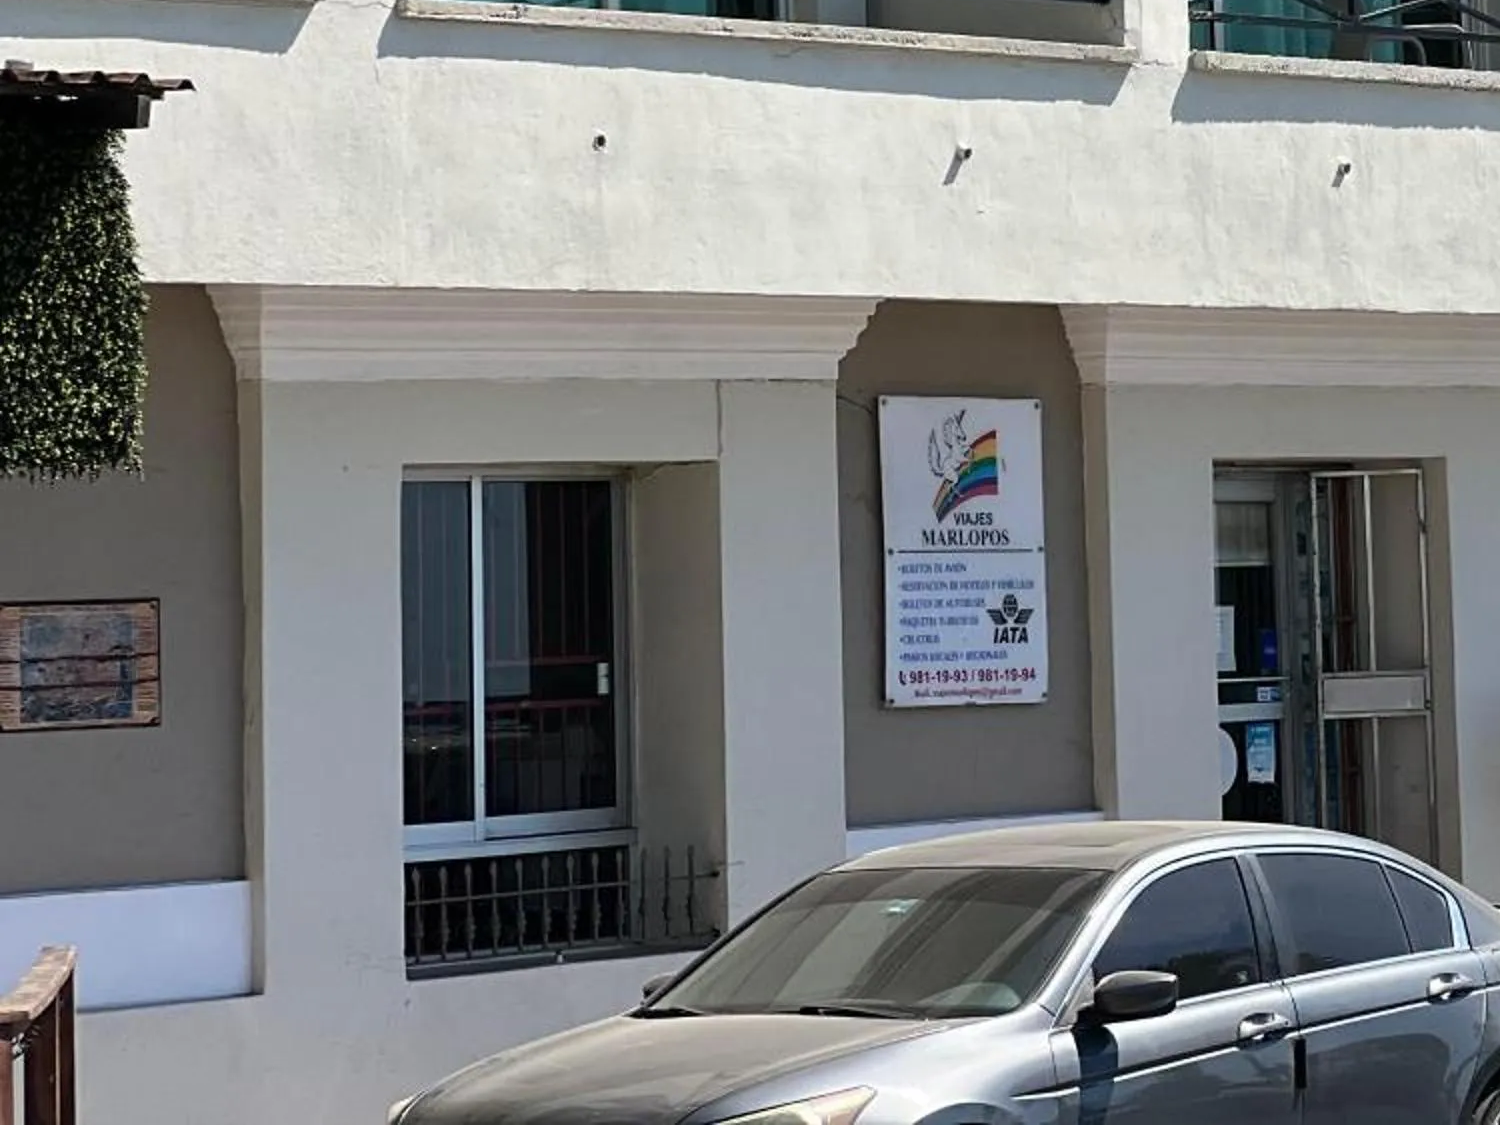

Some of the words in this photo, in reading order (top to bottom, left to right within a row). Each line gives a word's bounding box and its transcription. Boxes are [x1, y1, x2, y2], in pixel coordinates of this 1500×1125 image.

[953, 511, 993, 526] VIAJES
[921, 527, 1011, 547] MARLOPOS
[994, 626, 1029, 644] IATA
[909, 669, 969, 684] 981-19-93
